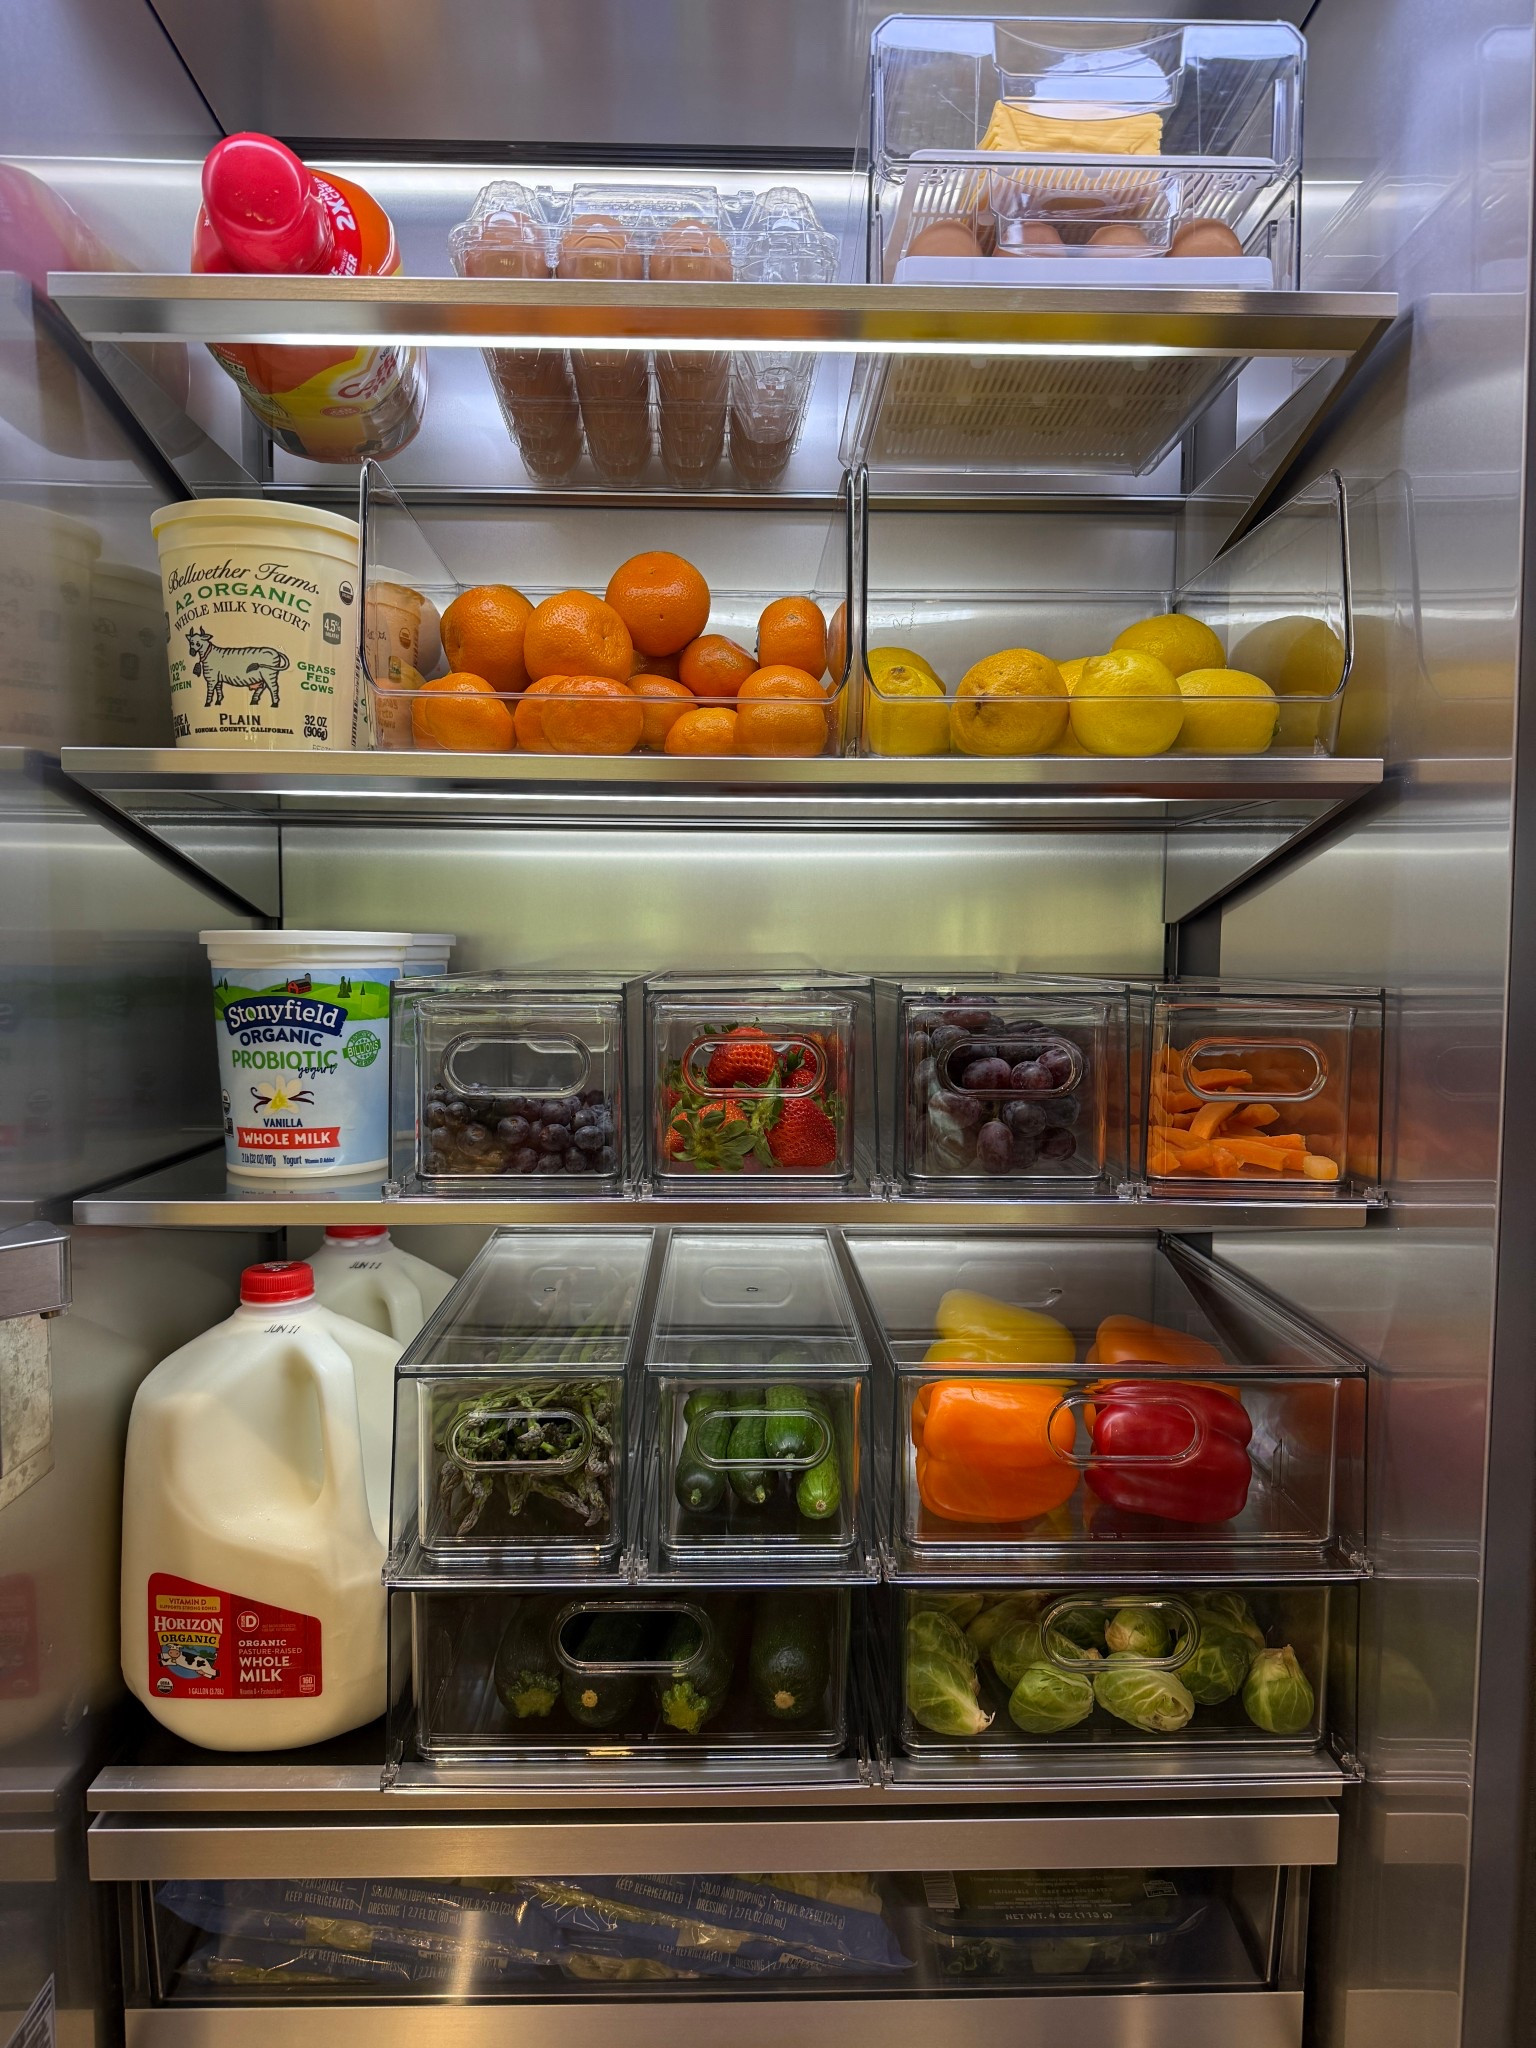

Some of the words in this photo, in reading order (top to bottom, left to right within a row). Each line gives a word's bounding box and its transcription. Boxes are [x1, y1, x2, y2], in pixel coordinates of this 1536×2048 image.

[326, 197, 357, 231] 2X
[168, 559, 251, 594] Bellwether
[175, 592, 195, 614] A2
[197, 582, 312, 613] ORGANIC
[174, 604, 210, 632] WHOLE
[213, 601, 248, 613] MILK
[251, 602, 311, 632] YOGURT
[324, 618, 341, 633] 4.5%
[297, 661, 336, 676] GRASS
[306, 672, 330, 684] FED
[300, 681, 334, 695] COWS
[219, 713, 261, 726] PLAIN
[304, 714, 316, 726] 32
[317, 716, 328, 727] OZ
[251, 727, 294, 735] CALIFORNIA
[303, 726, 329, 741] (906g)
[228, 1000, 339, 1028] Stonyfield
[240, 1028, 324, 1046] ORGANIC
[348, 1040, 379, 1057] BILLIONS
[232, 1050, 338, 1069] PROBIOTIC
[297, 1063, 339, 1080] yogurt
[263, 1118, 303, 1128] VANILLA
[243, 1132, 290, 1145] WHOLE
[294, 1131, 331, 1145] MILK
[283, 1155, 303, 1166] Yogurt
[349, 1261, 367, 1269] JUN
[368, 1261, 382, 1269] 11
[264, 1324, 288, 1334] JUN
[287, 1325, 301, 1334] 11
[169, 1598, 200, 1606] VITAMIN
[154, 1615, 224, 1635] HORIZON
[161, 1634, 217, 1645] ORGANIC
[238, 1639, 287, 1647] ORGANIC
[238, 1647, 303, 1655] PASTURE-RAISED
[239, 1656, 290, 1667] WHOLE
[240, 1668, 283, 1683] MILK
[371, 1884, 393, 1898] SALAD
[392, 1887, 407, 1900] AND
[407, 1889, 441, 1905] TOPPINGS
[615, 1878, 633, 1892] KEEP
[633, 1882, 684, 1905] REFRIGERATED
[699, 1881, 721, 1897] SALAD
[721, 1885, 735, 1900] AND
[736, 1889, 767, 1907] TOPPINGS
[285, 1890, 303, 1902] KEEP
[304, 1893, 354, 1910] REFRIGERATED
[474, 1898, 489, 1913] 8.25
[490, 1901, 499, 1913] OZ
[695, 1898, 728, 1916] DRESSING
[367, 1901, 400, 1917] DRESSING
[407, 1907, 418, 1918] 2.7
[418, 1908, 427, 1919] FL
[427, 1909, 437, 1922] OZ
[437, 1910, 449, 1924] (80
[734, 1907, 745, 1919] 2.7
[745, 1909, 753, 1921] FL
[753, 1911, 762, 1924] OZ
[762, 1912, 774, 1926] (80
[773, 1900, 787, 1913] NET
[787, 1902, 798, 1916] WT.
[799, 1905, 815, 1920] 8.25
[814, 1909, 823, 1923] OZ
[823, 1912, 838, 1926] (234
[1027, 1912, 1047, 1920] WT.
[318, 1949, 368, 1967] REFRIGERATED
[735, 1956, 765, 1971] DRESSING
